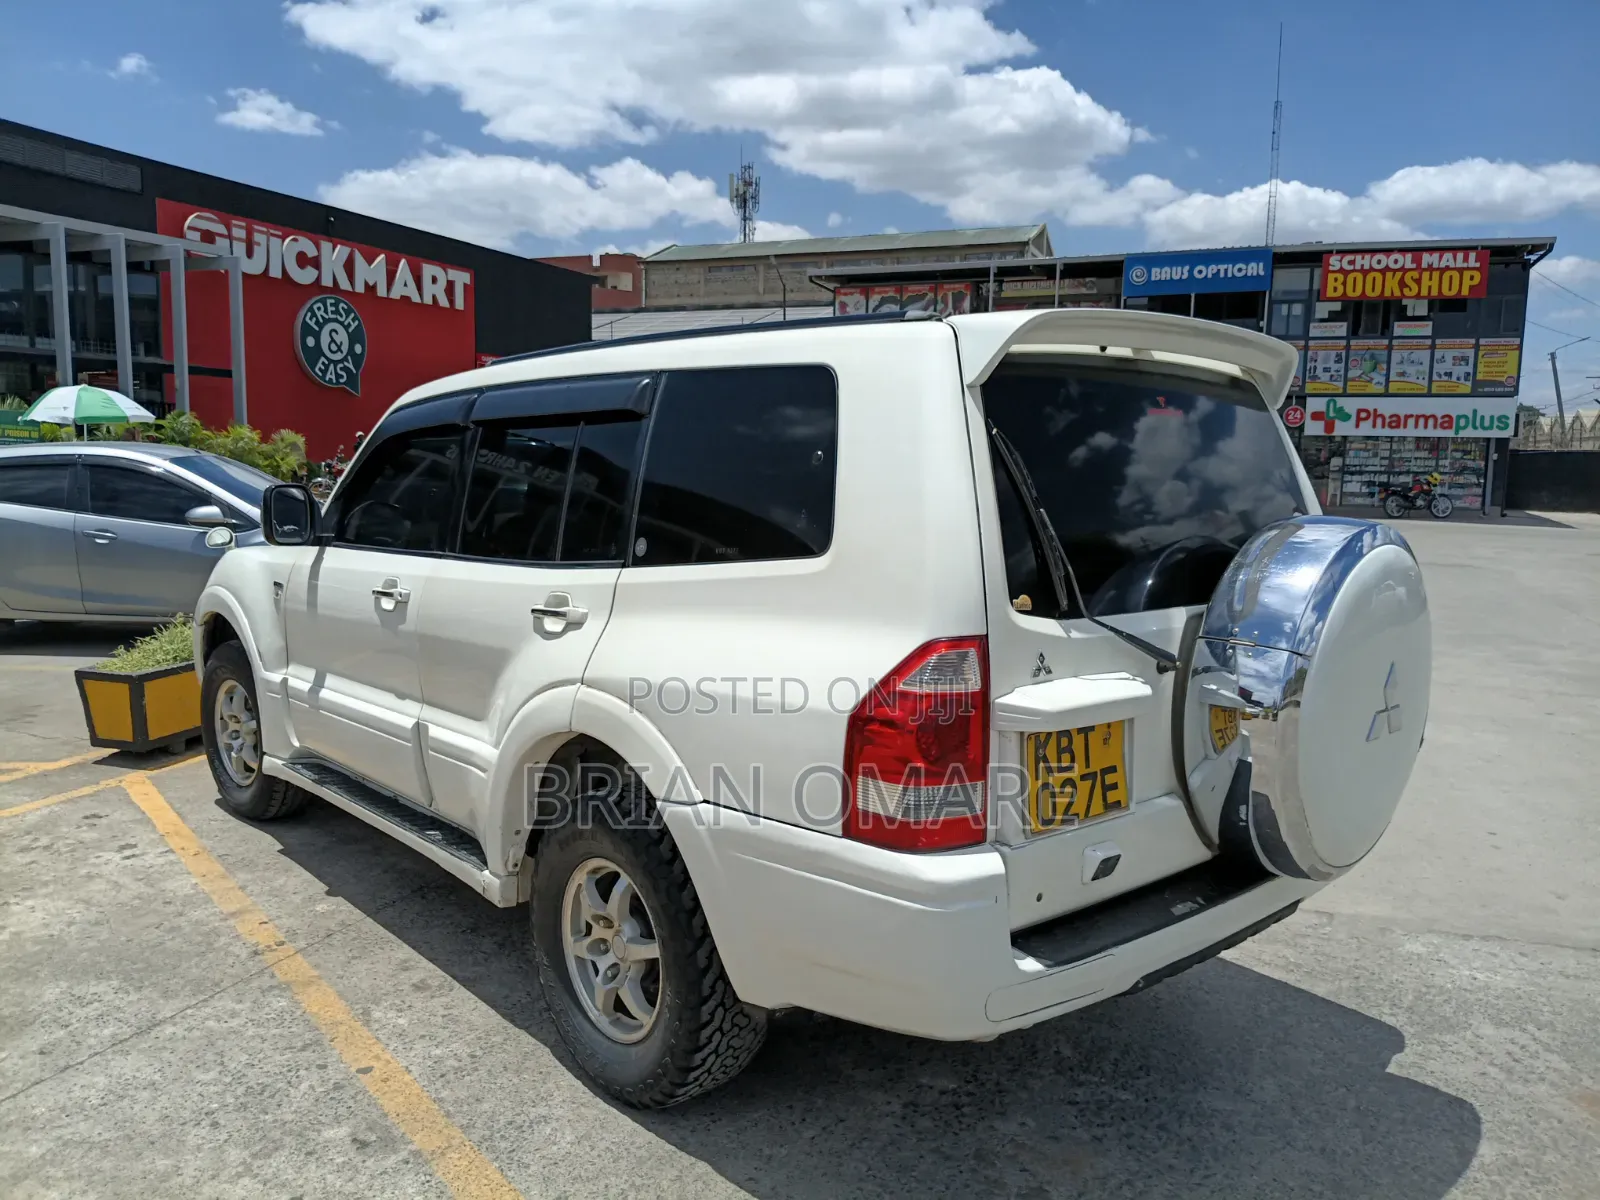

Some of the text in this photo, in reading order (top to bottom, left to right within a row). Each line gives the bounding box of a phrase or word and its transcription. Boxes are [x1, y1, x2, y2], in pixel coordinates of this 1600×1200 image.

[1151, 261, 1265, 281] BAUS OPTICAL
[1328, 251, 1481, 271] SCHOOL MALL
[1325, 269, 1482, 298] BOOKSHOP
[305, 298, 359, 333] FRESH
[327, 328, 344, 355] &
[314, 355, 357, 384] EASY
[1287, 410, 1302, 420] 24
[1355, 408, 1510, 436] Pharmaplus
[1034, 725, 1096, 781] KBT
[1035, 765, 1122, 828] 027E
